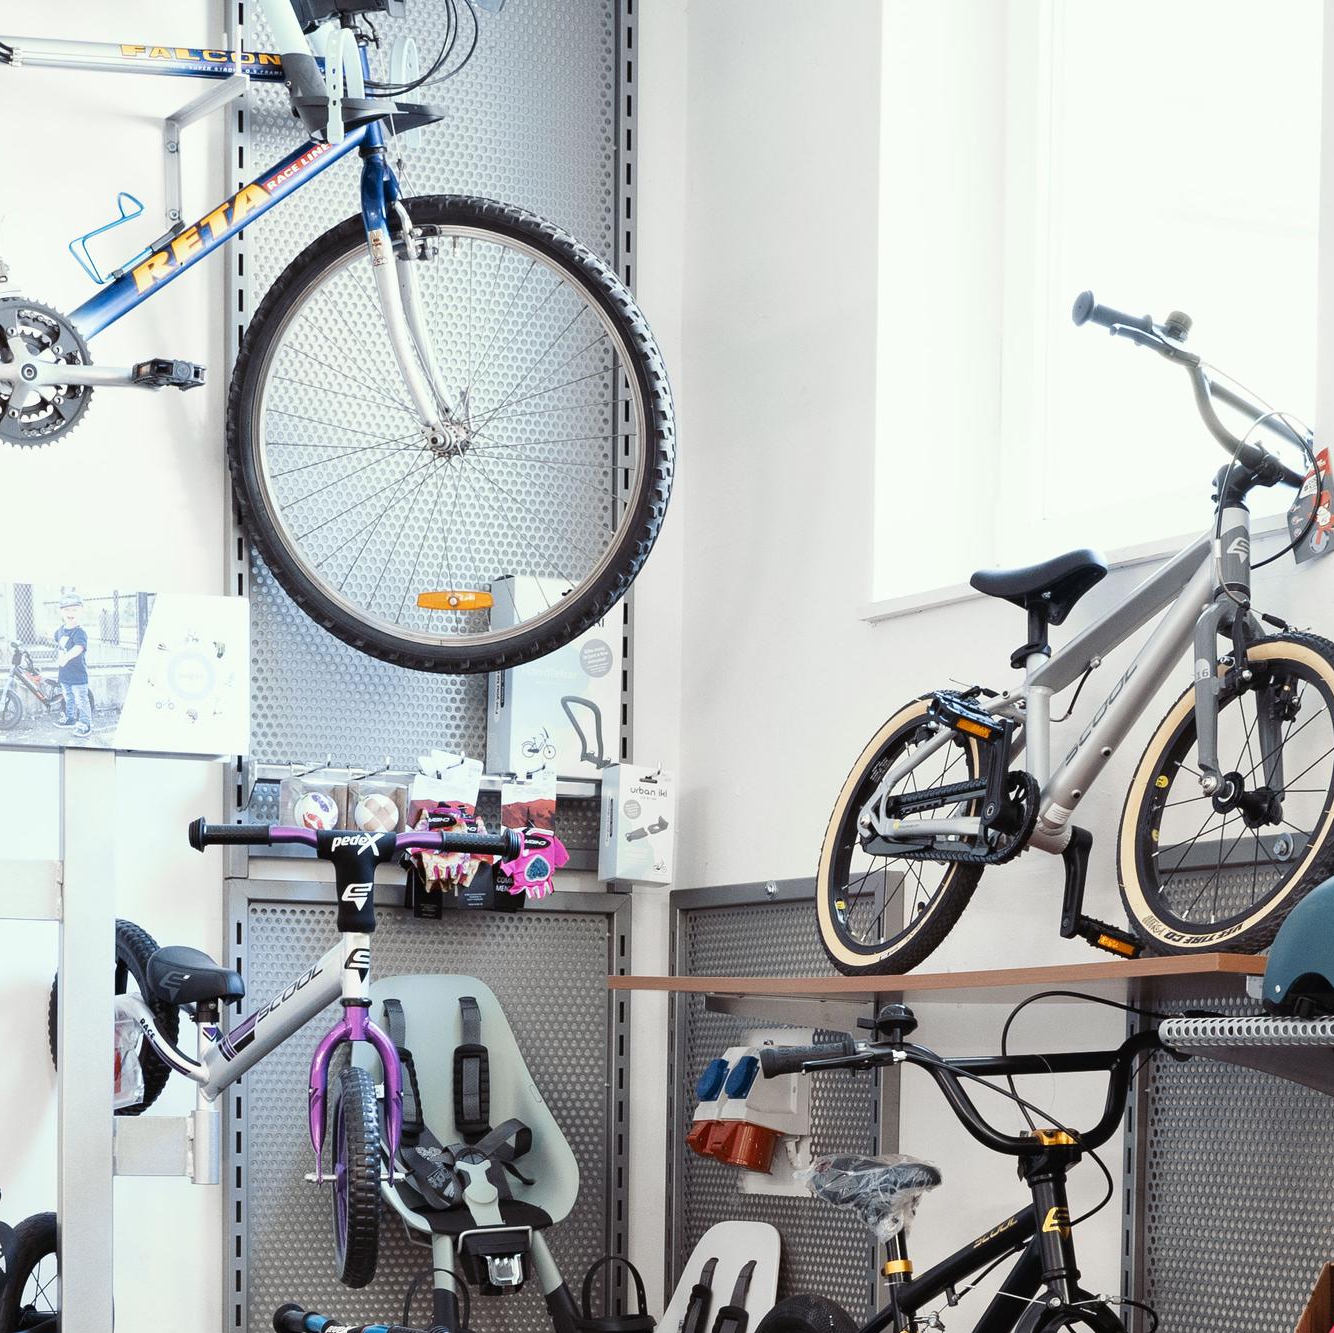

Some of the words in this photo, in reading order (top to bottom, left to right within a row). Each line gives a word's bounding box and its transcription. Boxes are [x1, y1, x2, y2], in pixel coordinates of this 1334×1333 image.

[120, 44, 282, 66] FALCON
[267, 164, 300, 191] RACE
[300, 142, 332, 167] LINE
[132, 182, 272, 295] RETA
[1066, 665, 1138, 767] SCOOL
[630, 786, 656, 797] urban
[331, 832, 386, 857] pedeX
[257, 965, 324, 1021] SCOOL
[139, 1017, 156, 1040] RACE
